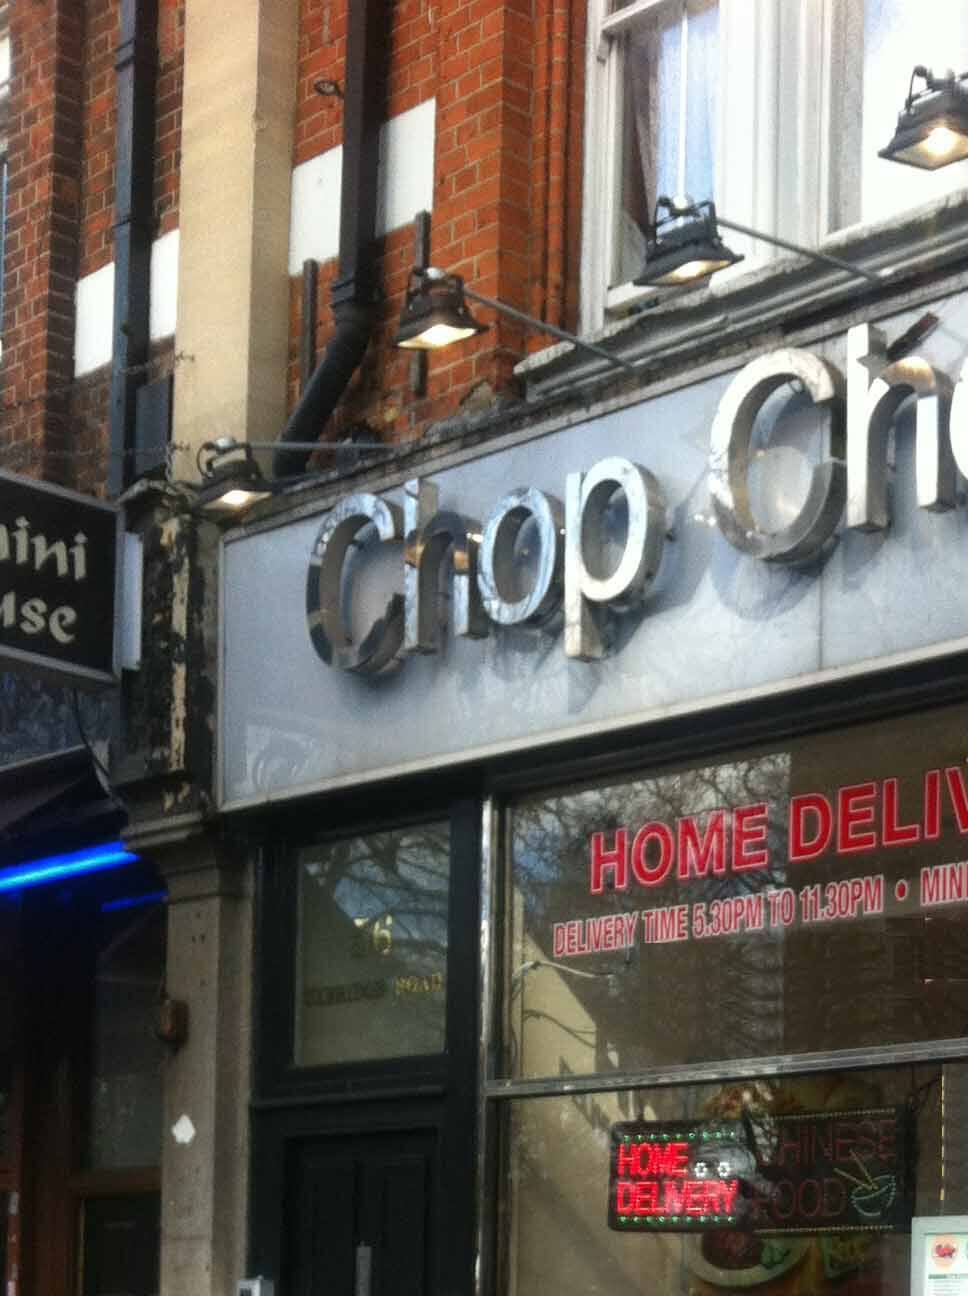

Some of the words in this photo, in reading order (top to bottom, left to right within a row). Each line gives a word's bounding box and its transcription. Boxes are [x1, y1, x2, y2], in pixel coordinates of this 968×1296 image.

[306, 453, 662, 676] Chop
[589, 803, 769, 895] HOME
[552, 911, 638, 958] DELIVERY
[644, 905, 689, 944] TIME
[692, 894, 764, 939] 5.30PM
[768, 887, 796, 927] TO
[799, 874, 884, 923] 11.30PM
[615, 1180, 740, 1217] DELIVERY
[616, 1142, 690, 1178] HOME
